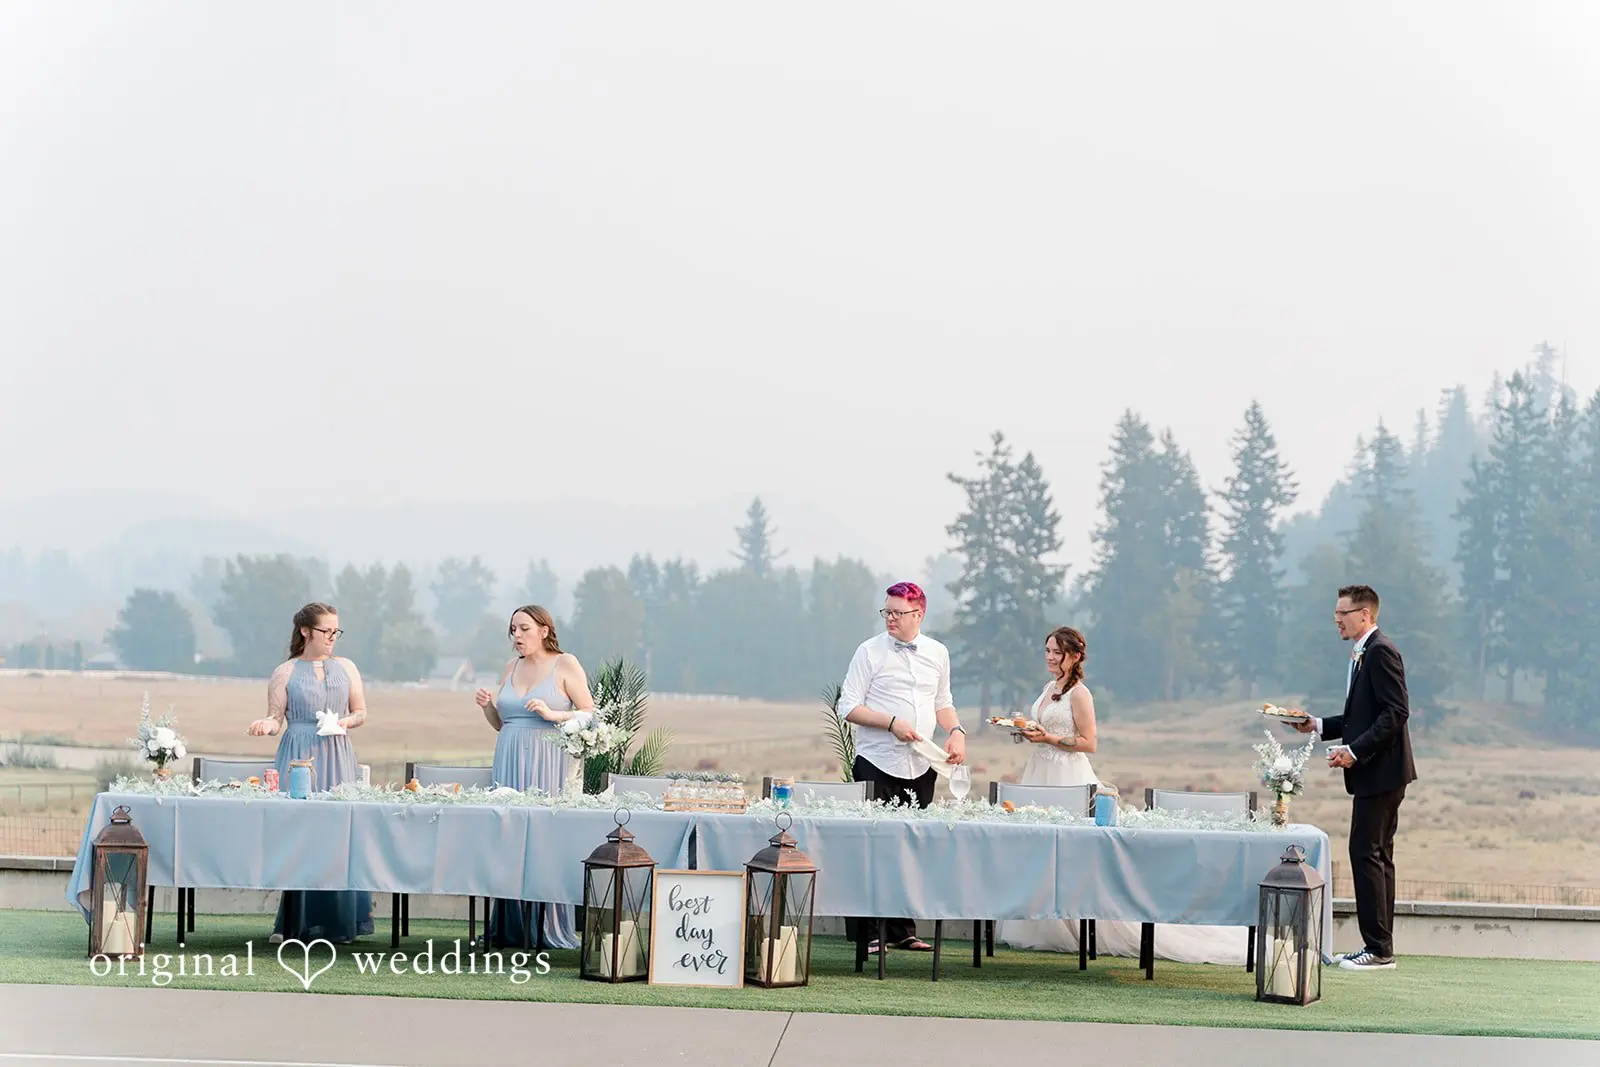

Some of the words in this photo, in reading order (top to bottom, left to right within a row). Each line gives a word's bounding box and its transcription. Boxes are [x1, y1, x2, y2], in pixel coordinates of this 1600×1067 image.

[668, 884, 714, 915] best
[676, 912, 714, 950] day
[673, 949, 728, 974] ever
